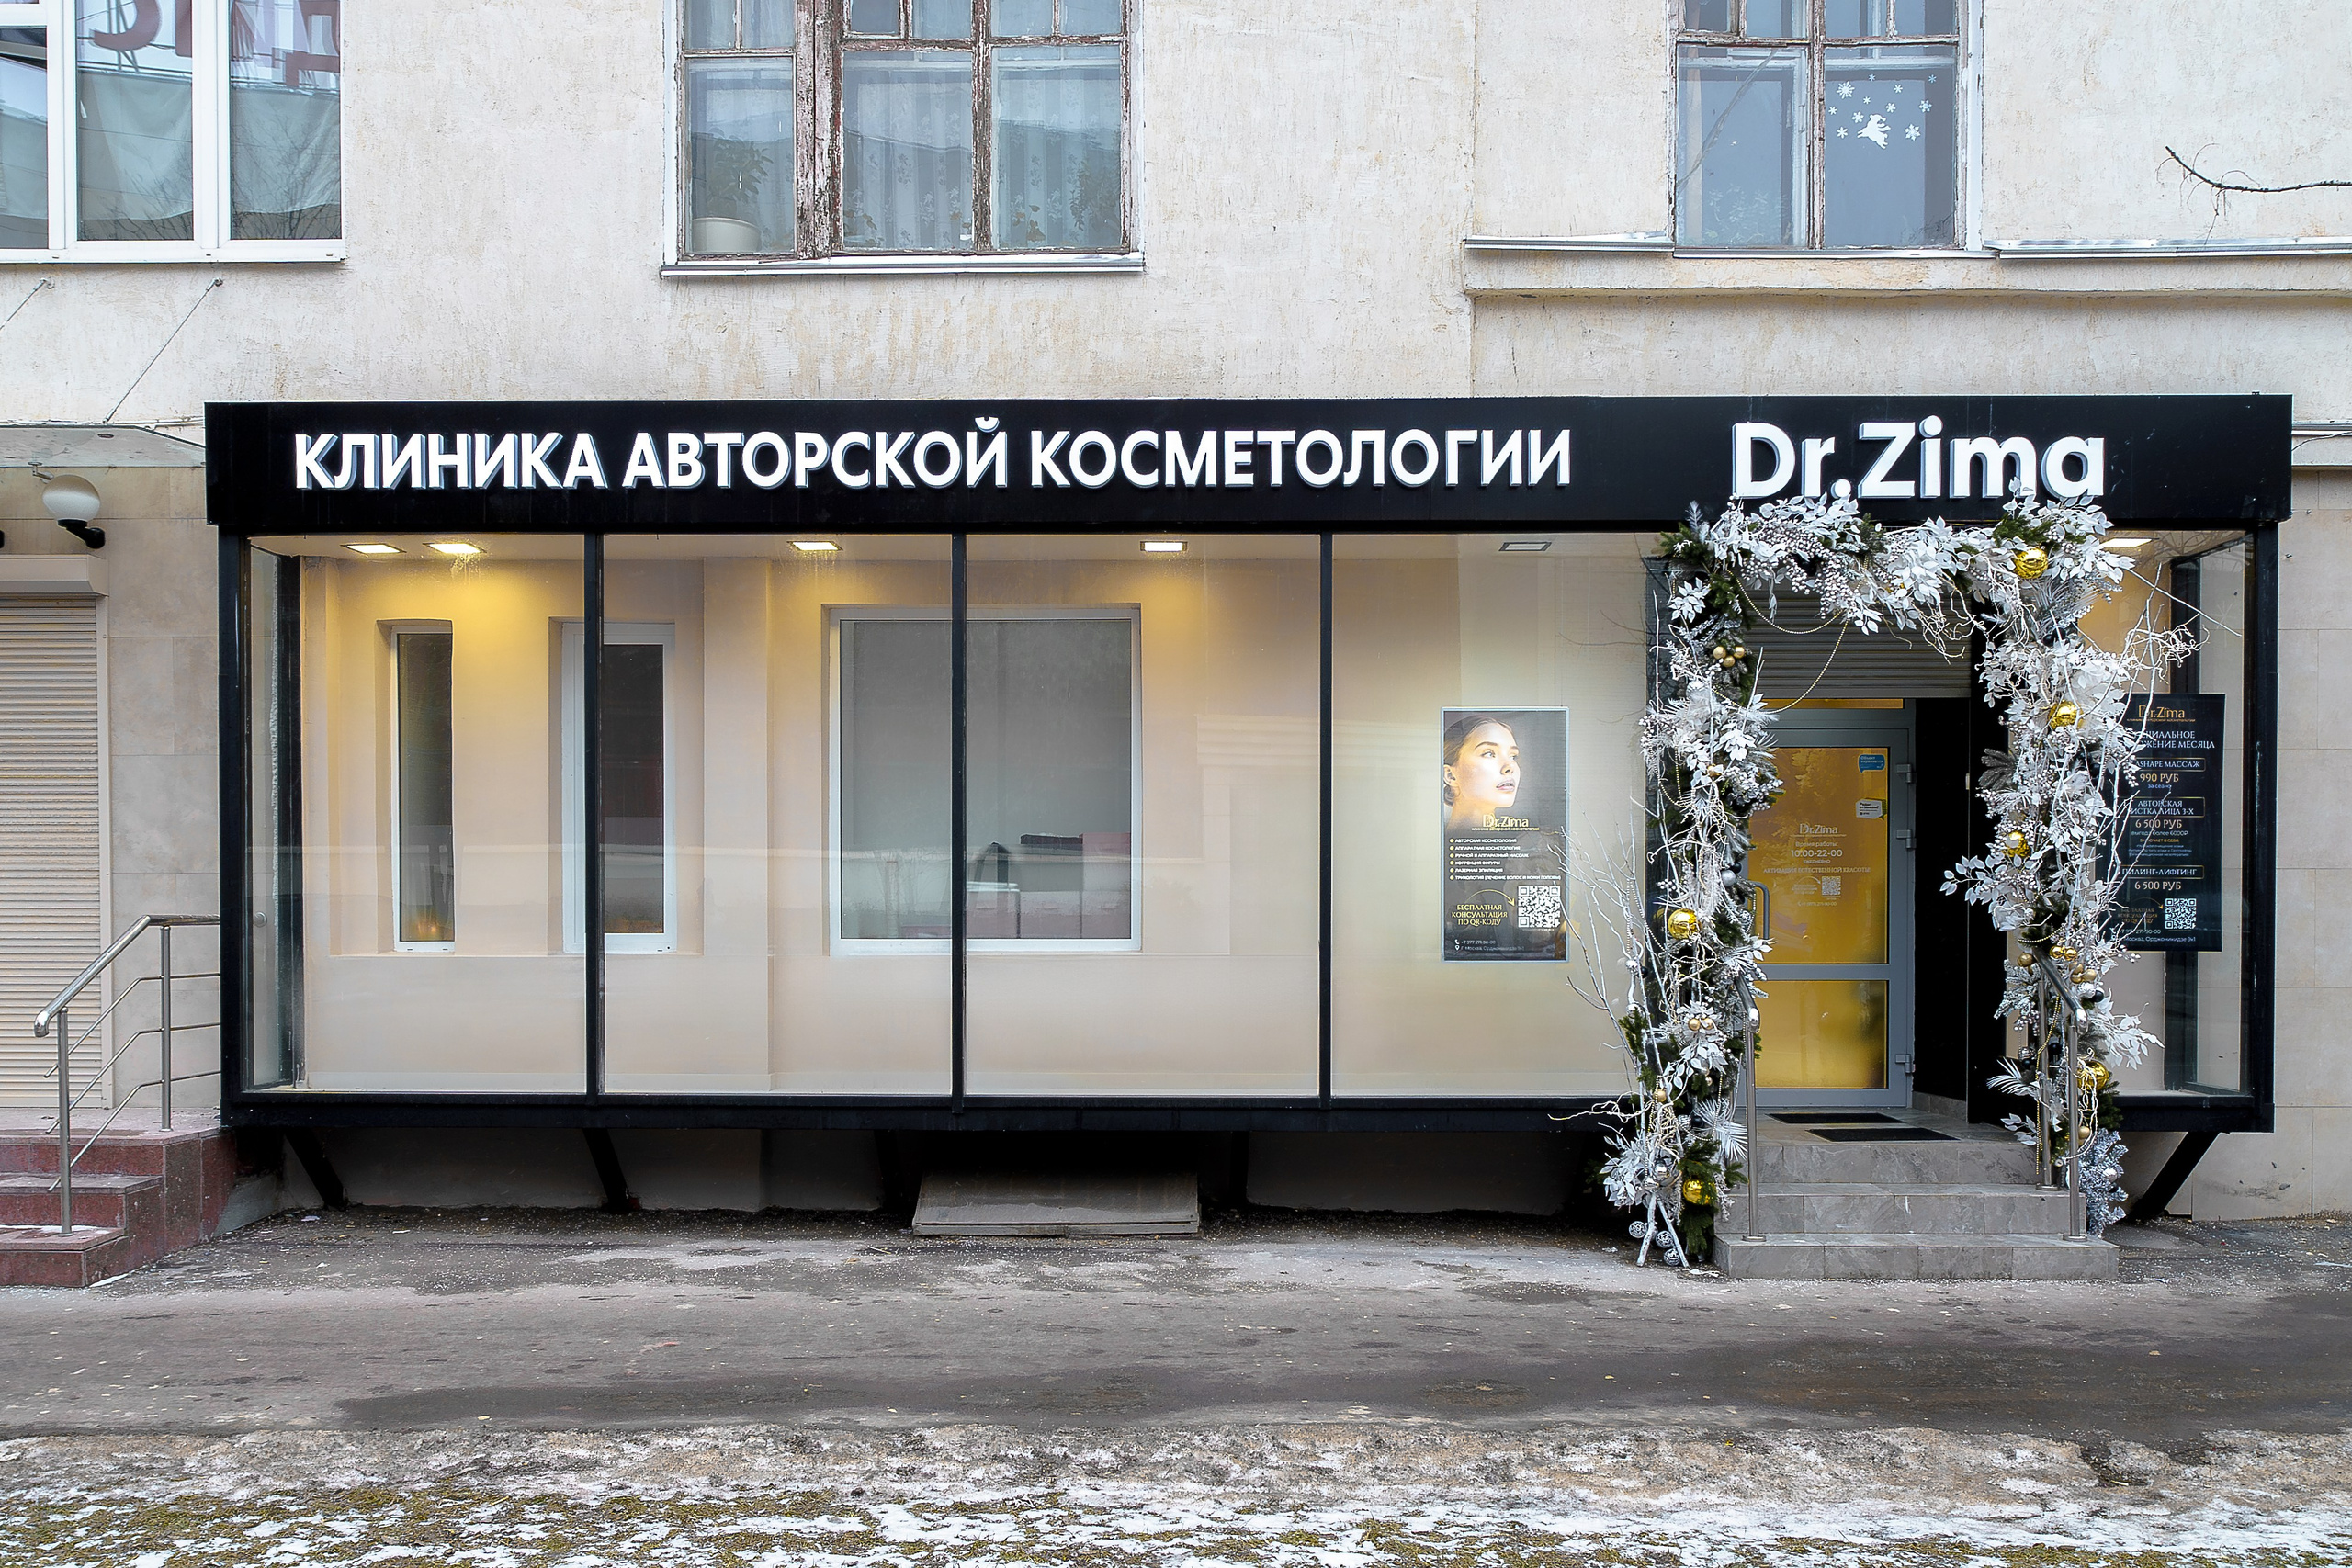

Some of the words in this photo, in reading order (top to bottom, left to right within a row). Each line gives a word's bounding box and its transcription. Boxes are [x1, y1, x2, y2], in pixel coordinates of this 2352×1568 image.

[295, 432, 607, 490] КЛИНИКА
[622, 417, 1007, 489] АВТОРСКОЙ
[1031, 430, 1571, 489] КОСМЕТОЛОГИИ
[1732, 415, 2105, 499] Dr.Zima
[2139, 705, 2185, 718] Dr.Zima
[2177, 740, 2214, 750] МЕСЯЦА
[2139, 773, 2157, 783] 990
[2161, 773, 2179, 783] РУБ
[1483, 814, 1529, 827] Dr.Zima
[2135, 819, 2141, 829] 6
[2144, 819, 2161, 829] 500
[2163, 819, 2183, 829] РУБ
[1799, 823, 1838, 834] Dr.Zima
[2163, 882, 2181, 891] РУБ
